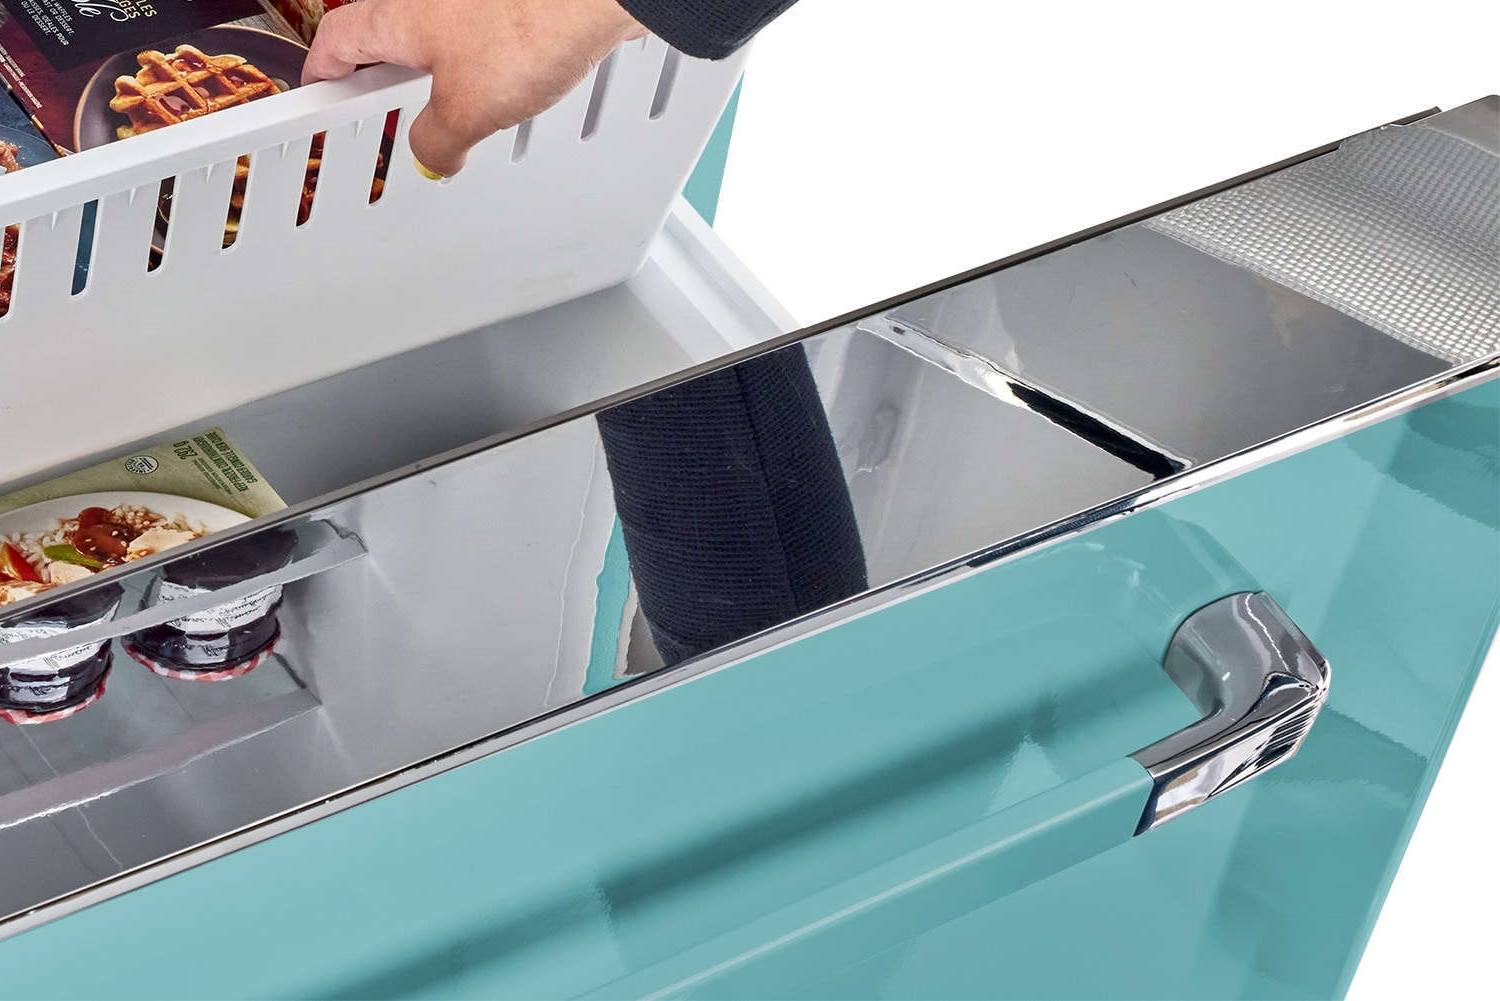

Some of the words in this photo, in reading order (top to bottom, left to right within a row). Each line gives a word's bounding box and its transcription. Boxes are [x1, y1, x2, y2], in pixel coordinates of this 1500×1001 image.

[21, 0, 30, 8] OU
[54, 2, 72, 22] WAFFLES
[174, 445, 198, 460] 292
